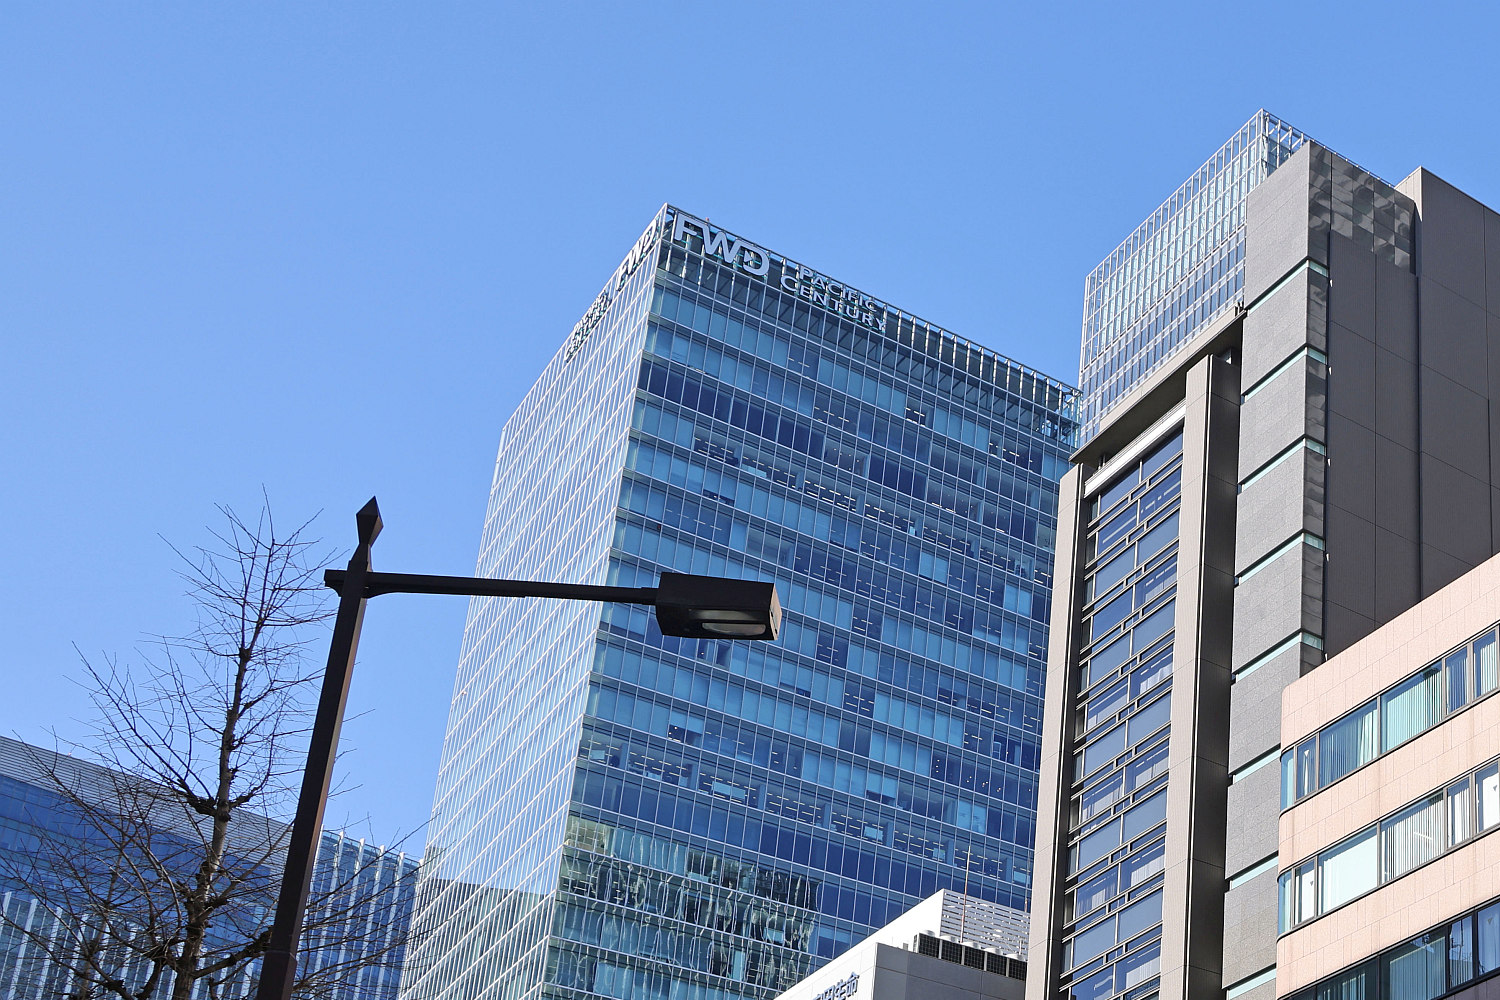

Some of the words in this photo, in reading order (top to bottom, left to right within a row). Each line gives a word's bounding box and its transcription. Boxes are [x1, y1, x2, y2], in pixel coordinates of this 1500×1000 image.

[674, 213, 769, 276] FWD
[781, 275, 886, 332] CENTURY
[800, 265, 879, 313] PACIFIC
